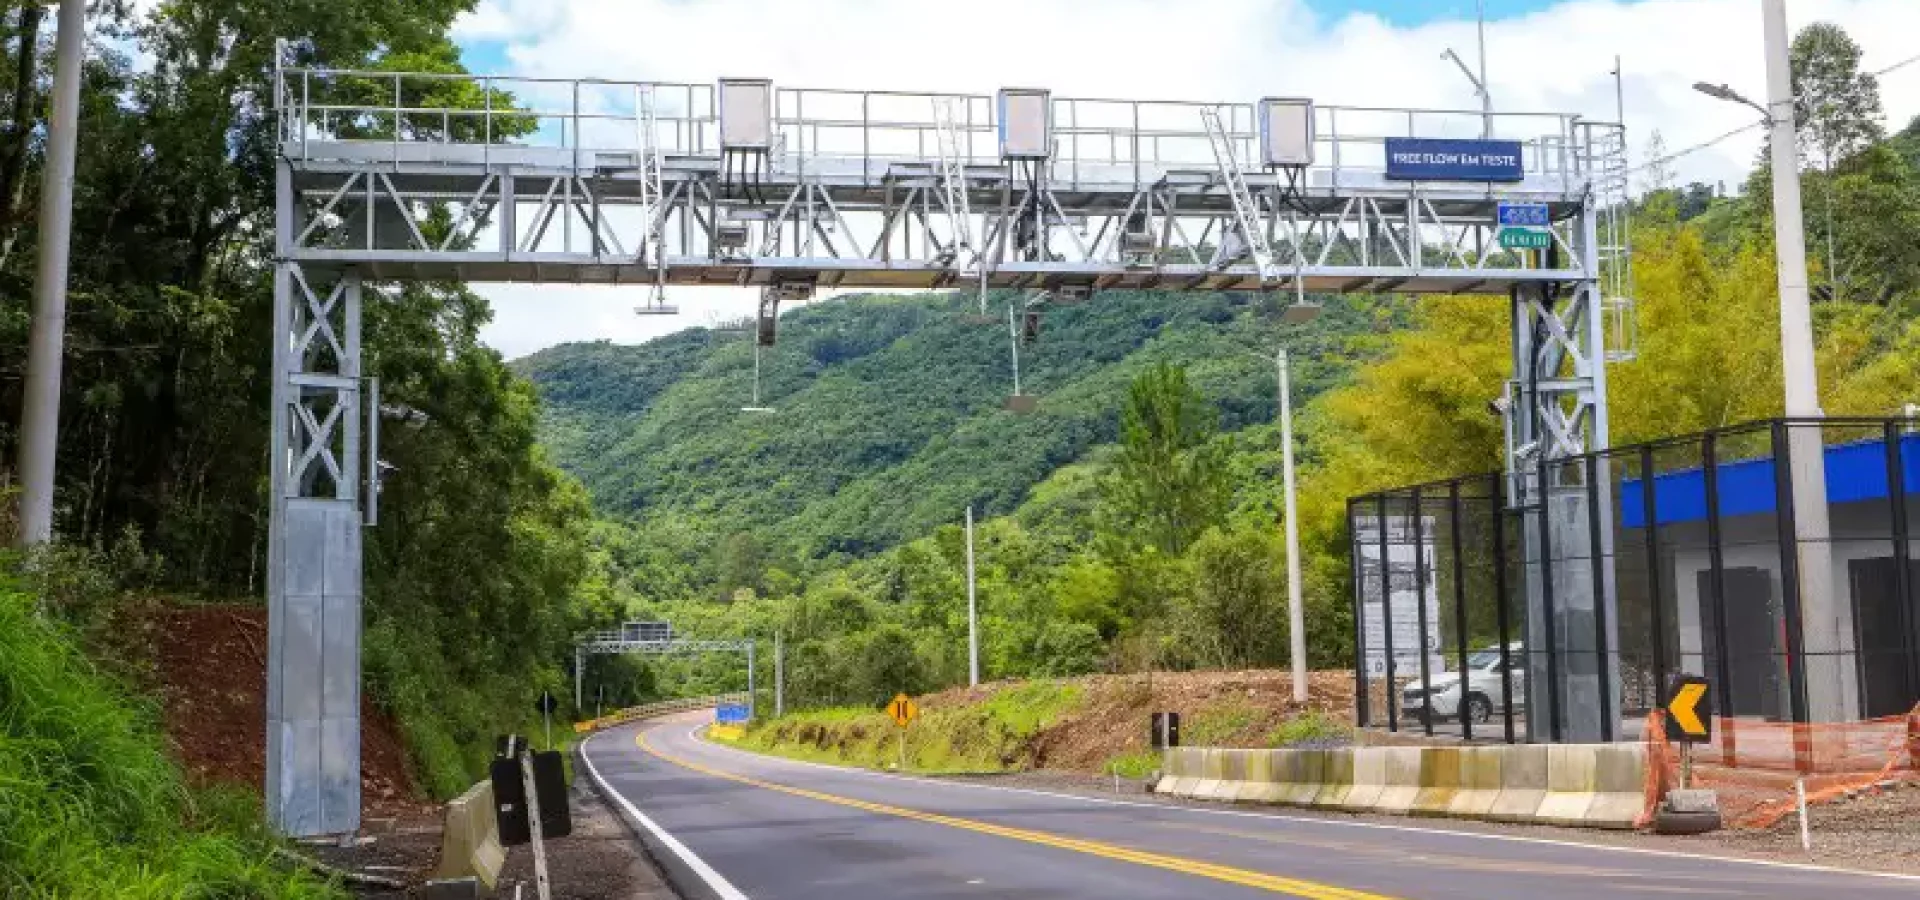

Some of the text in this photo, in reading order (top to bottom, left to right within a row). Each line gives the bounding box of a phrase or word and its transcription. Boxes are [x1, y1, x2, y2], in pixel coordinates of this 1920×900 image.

[1393, 153, 1421, 164] FREE
[1423, 153, 1458, 165] FLOW
[1482, 154, 1516, 167] TESTE
